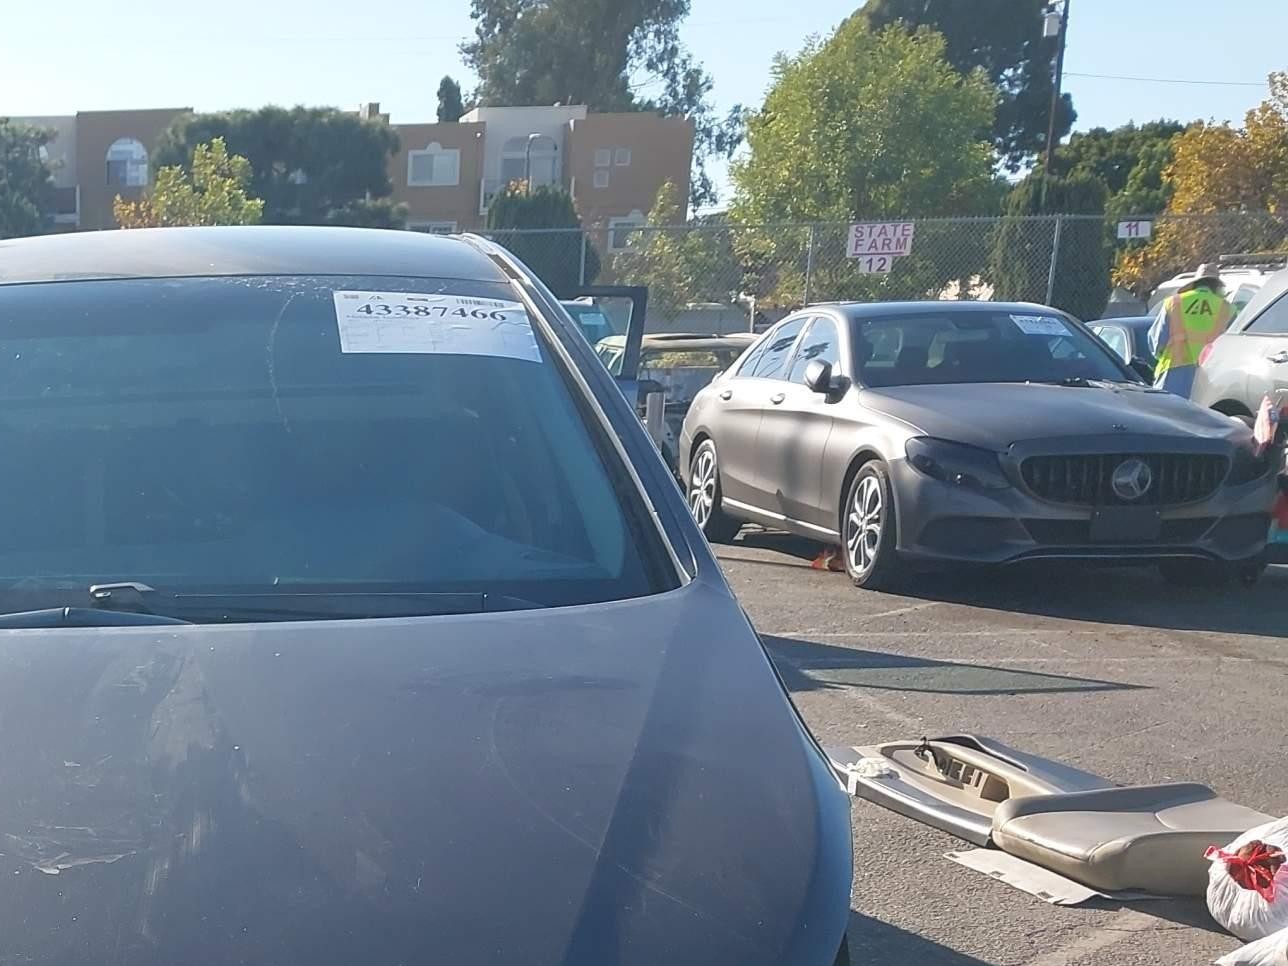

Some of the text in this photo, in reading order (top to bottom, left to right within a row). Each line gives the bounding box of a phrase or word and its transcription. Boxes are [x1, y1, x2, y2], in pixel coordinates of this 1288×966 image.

[854, 224, 912, 238] STATE
[1124, 222, 1139, 237] 11
[854, 238, 908, 252] FARM
[866, 257, 887, 272] 12
[356, 304, 507, 321] 43387466
